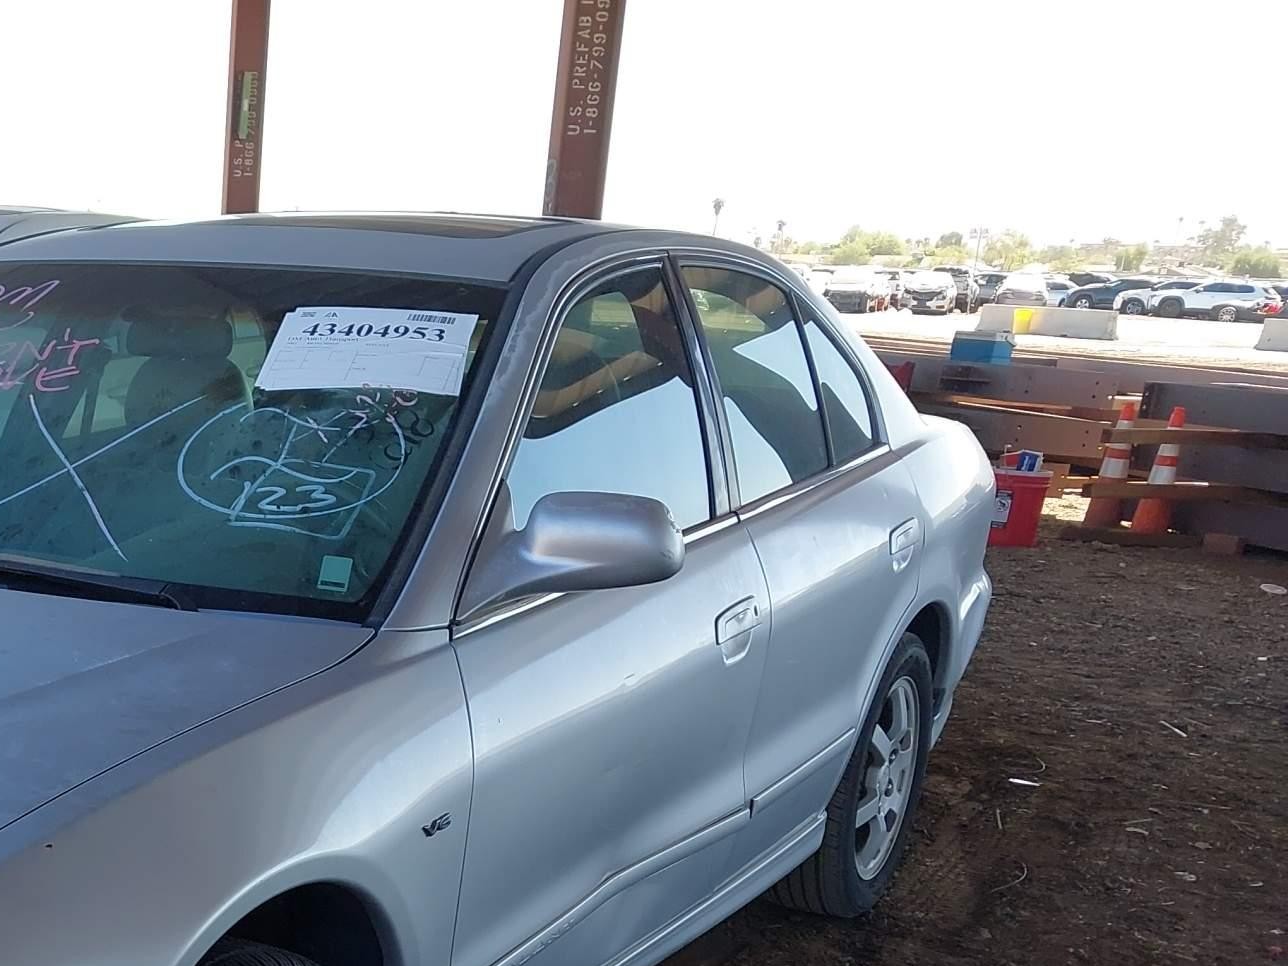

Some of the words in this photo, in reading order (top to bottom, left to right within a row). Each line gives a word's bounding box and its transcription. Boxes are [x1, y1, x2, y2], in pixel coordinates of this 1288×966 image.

[572, 16, 592, 88] PREFAB
[567, 100, 583, 135] U.S.
[302, 322, 446, 343] 43404953
[230, 481, 336, 512] 123
